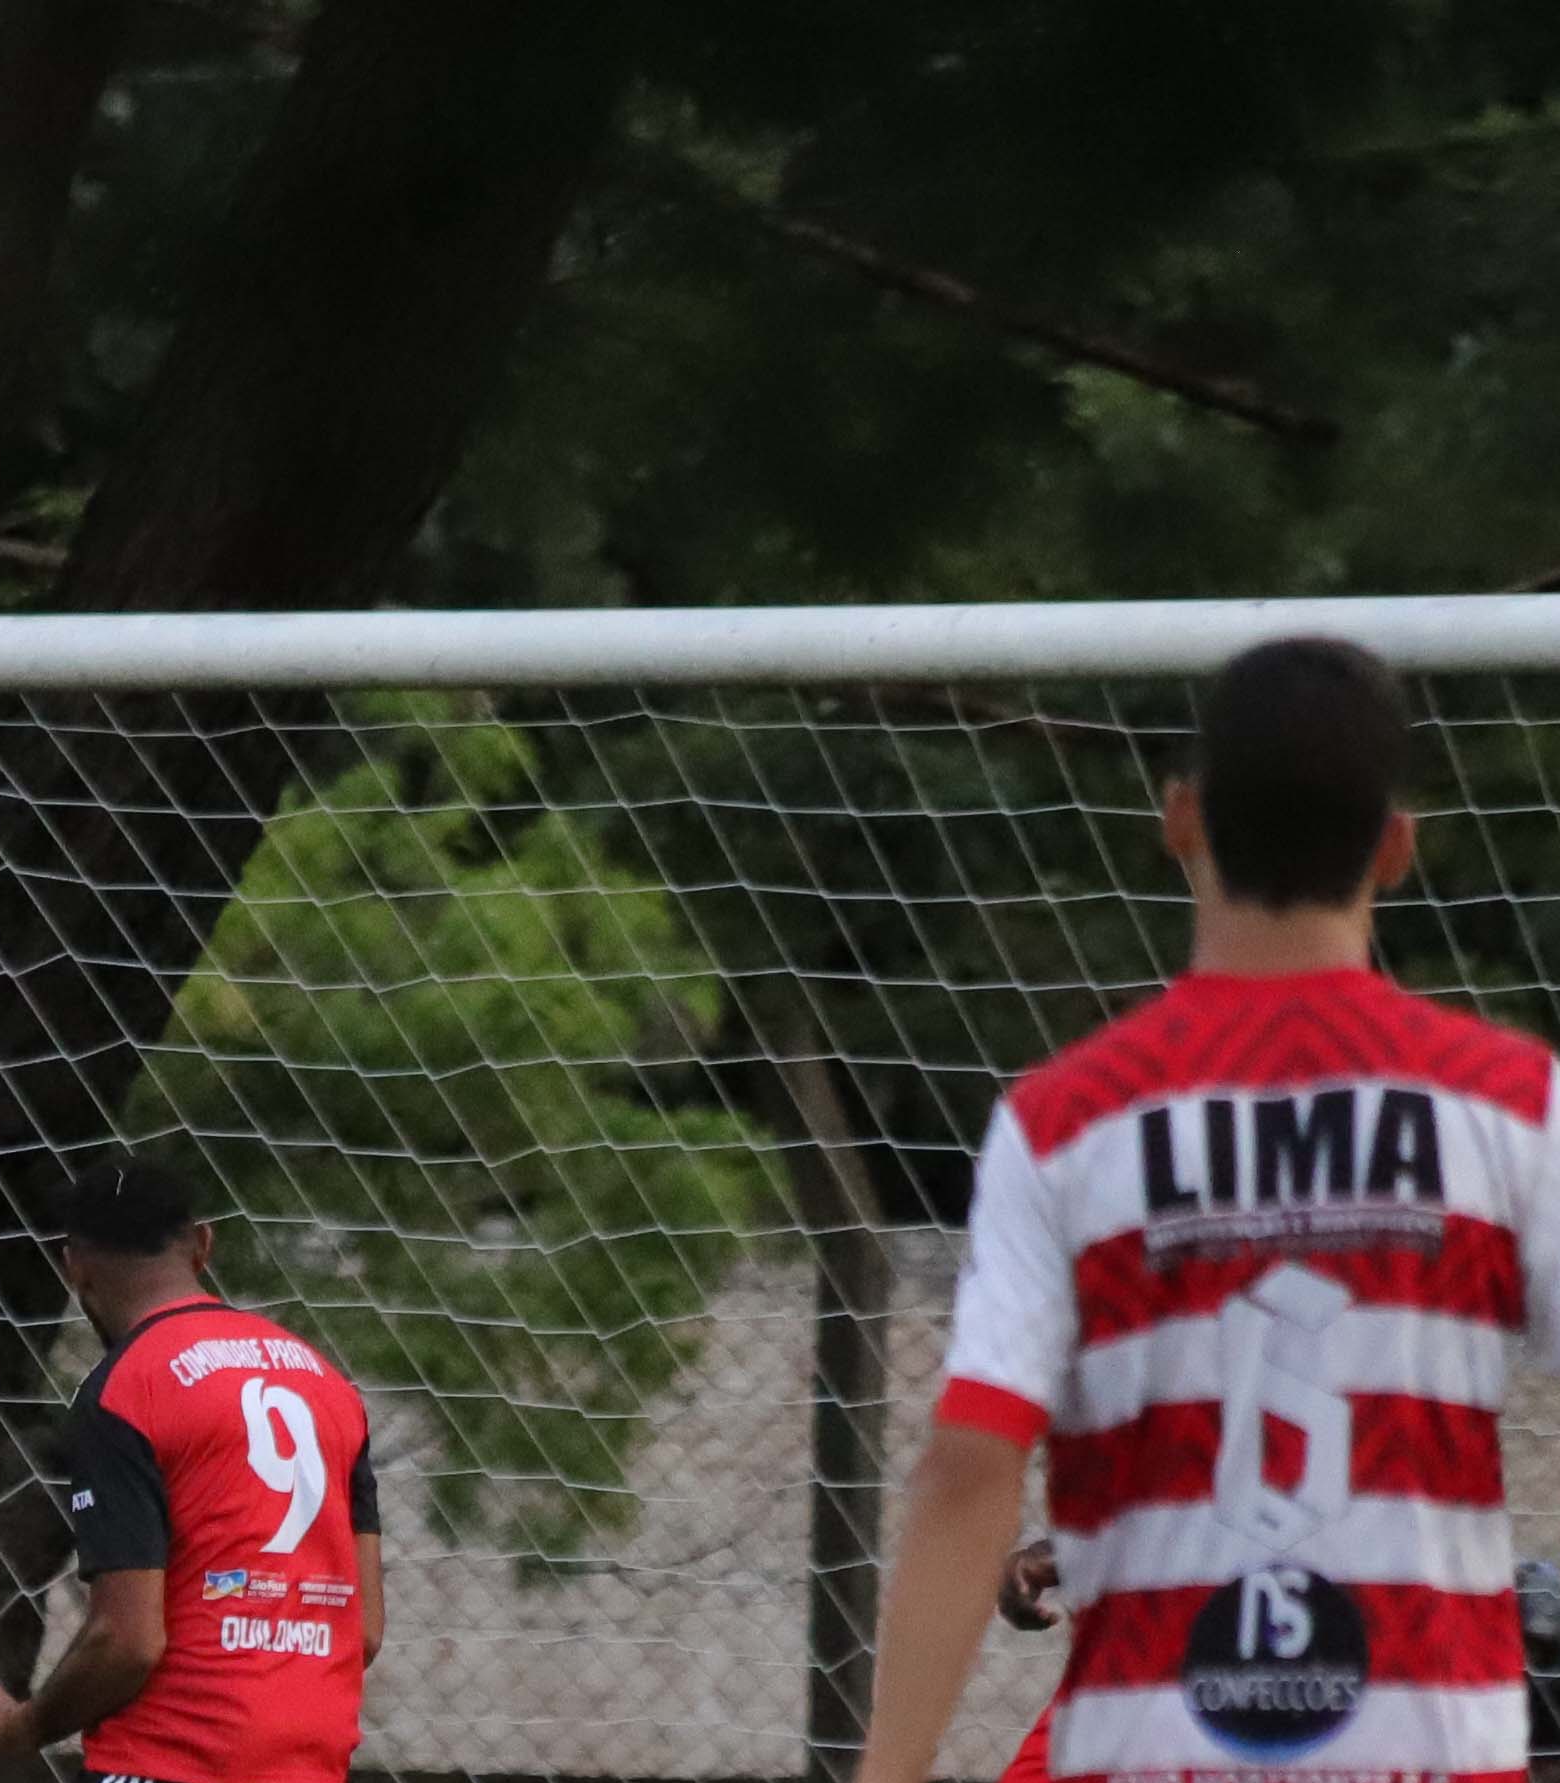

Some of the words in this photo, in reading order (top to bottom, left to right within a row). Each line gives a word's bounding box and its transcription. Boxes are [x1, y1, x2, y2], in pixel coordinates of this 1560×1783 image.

[1140, 1088, 1445, 1212] LIMA
[241, 1376, 327, 1554] 9
[221, 1615, 331, 1657] QUILOMBO
